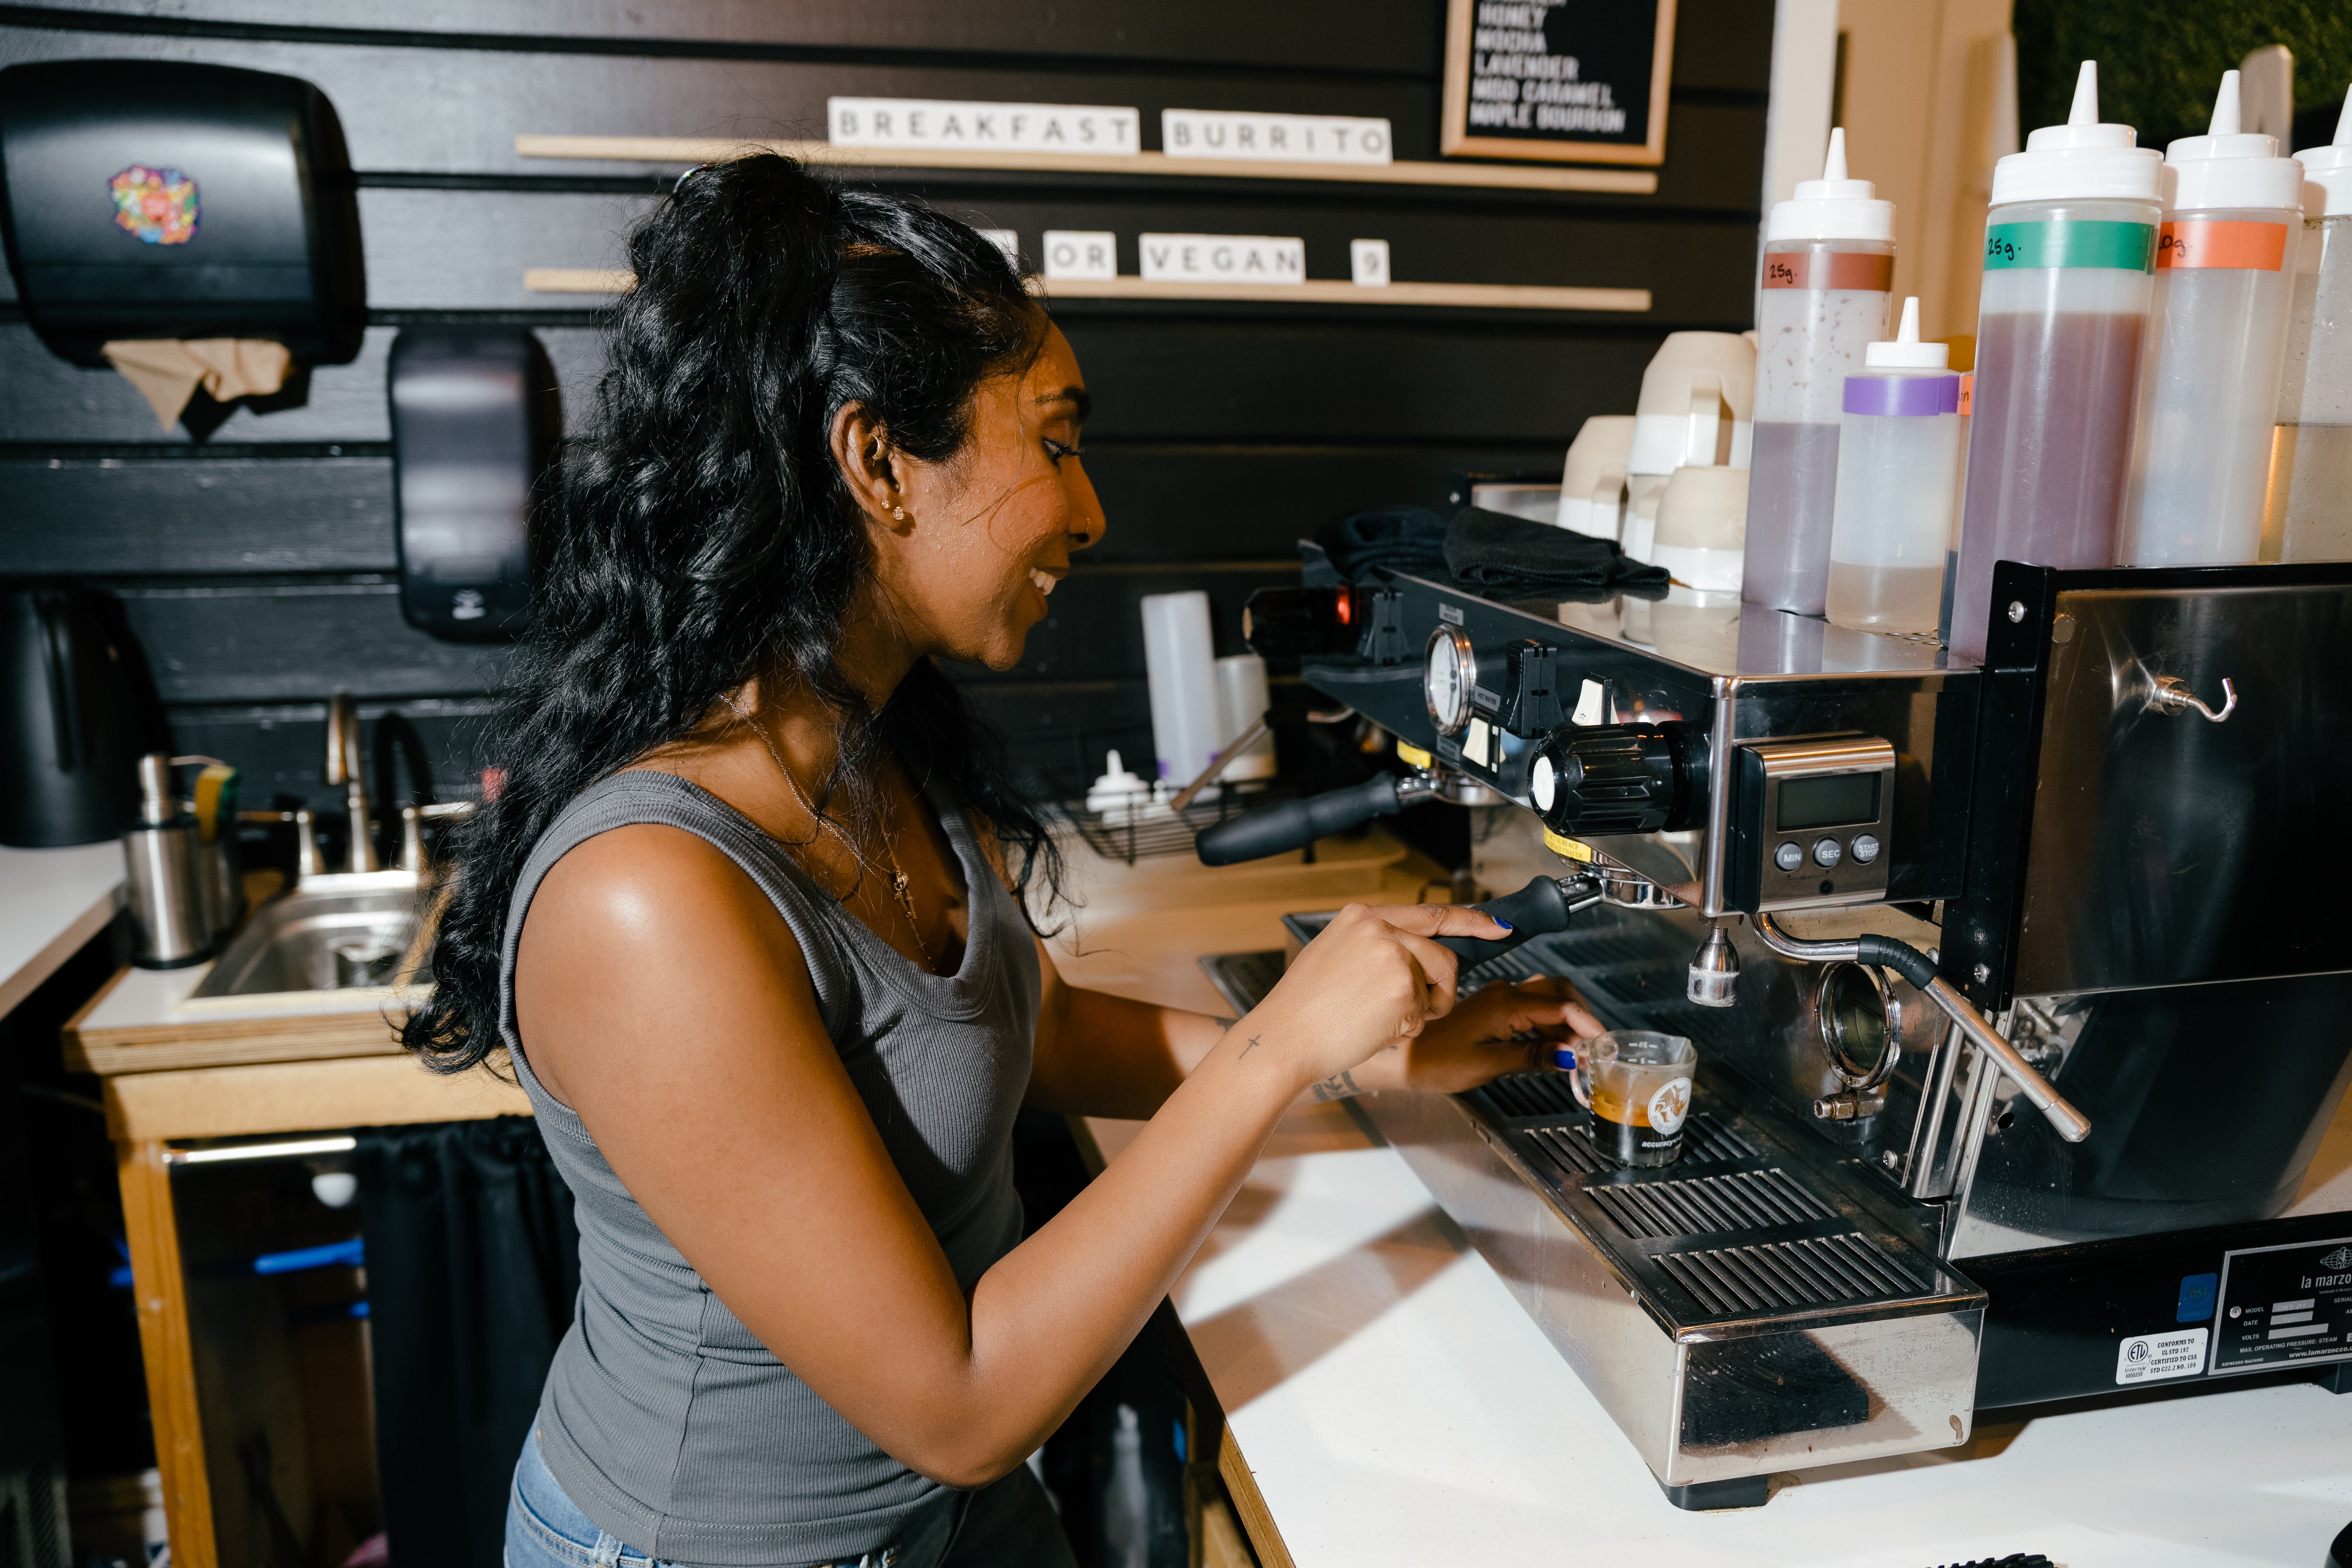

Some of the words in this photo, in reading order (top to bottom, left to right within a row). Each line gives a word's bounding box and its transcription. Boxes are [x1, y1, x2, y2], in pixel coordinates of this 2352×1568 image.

[1474, 52, 1580, 79] LAVENDER
[839, 110, 1131, 142] BREAKFAST
[1173, 122, 1384, 155] BURRITO
[1053, 243, 1107, 270] OR
[1148, 246, 1299, 274] VEGAN
[1363, 252, 1380, 276] 9
[1485, 695, 1496, 705] WATER
[1491, 763, 1498, 773] ON
[1557, 837, 1579, 850] SURFACE
[1858, 842, 1879, 851] START
[1562, 848, 1583, 859] CHAUDE
[1784, 853, 1801, 862] MIN
[1821, 849, 1840, 859] SEC
[1651, 1115, 1663, 1129] RHINO
[2301, 1276, 2311, 1289] la
[2158, 1339, 2187, 1348] CONFORMS
[2254, 1343, 2286, 1351] OPERATING
[2286, 1339, 2317, 1348] PRESSURE:
[2130, 1344, 2145, 1360] ETL
[2151, 1357, 2179, 1365] CERTIFIED
